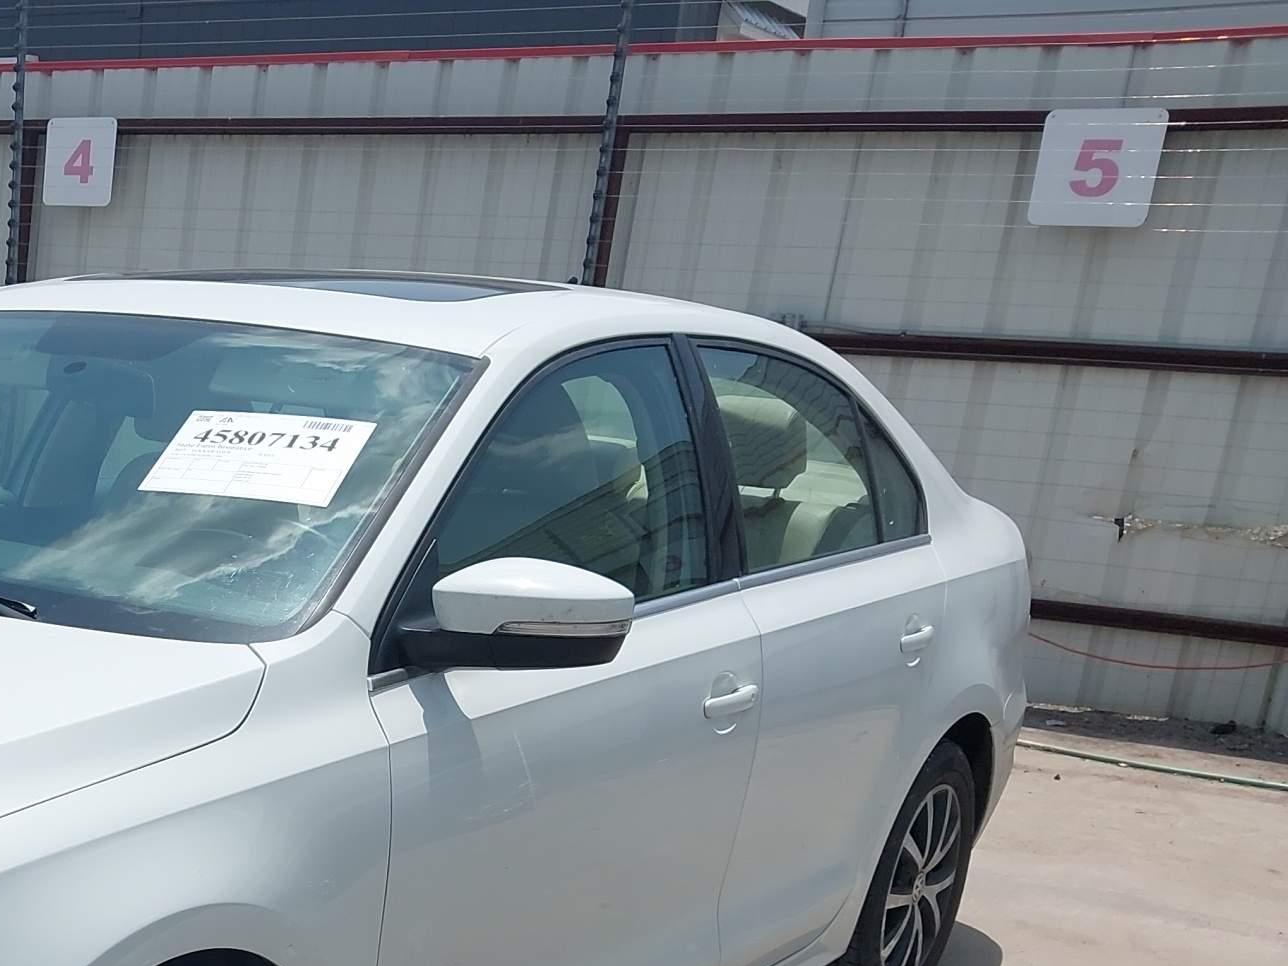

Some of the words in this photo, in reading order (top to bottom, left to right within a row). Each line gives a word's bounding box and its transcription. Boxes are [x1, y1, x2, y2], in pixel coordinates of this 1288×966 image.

[63, 139, 94, 184] 4
[1068, 139, 1124, 198] 5
[193, 428, 340, 453] 45807134
